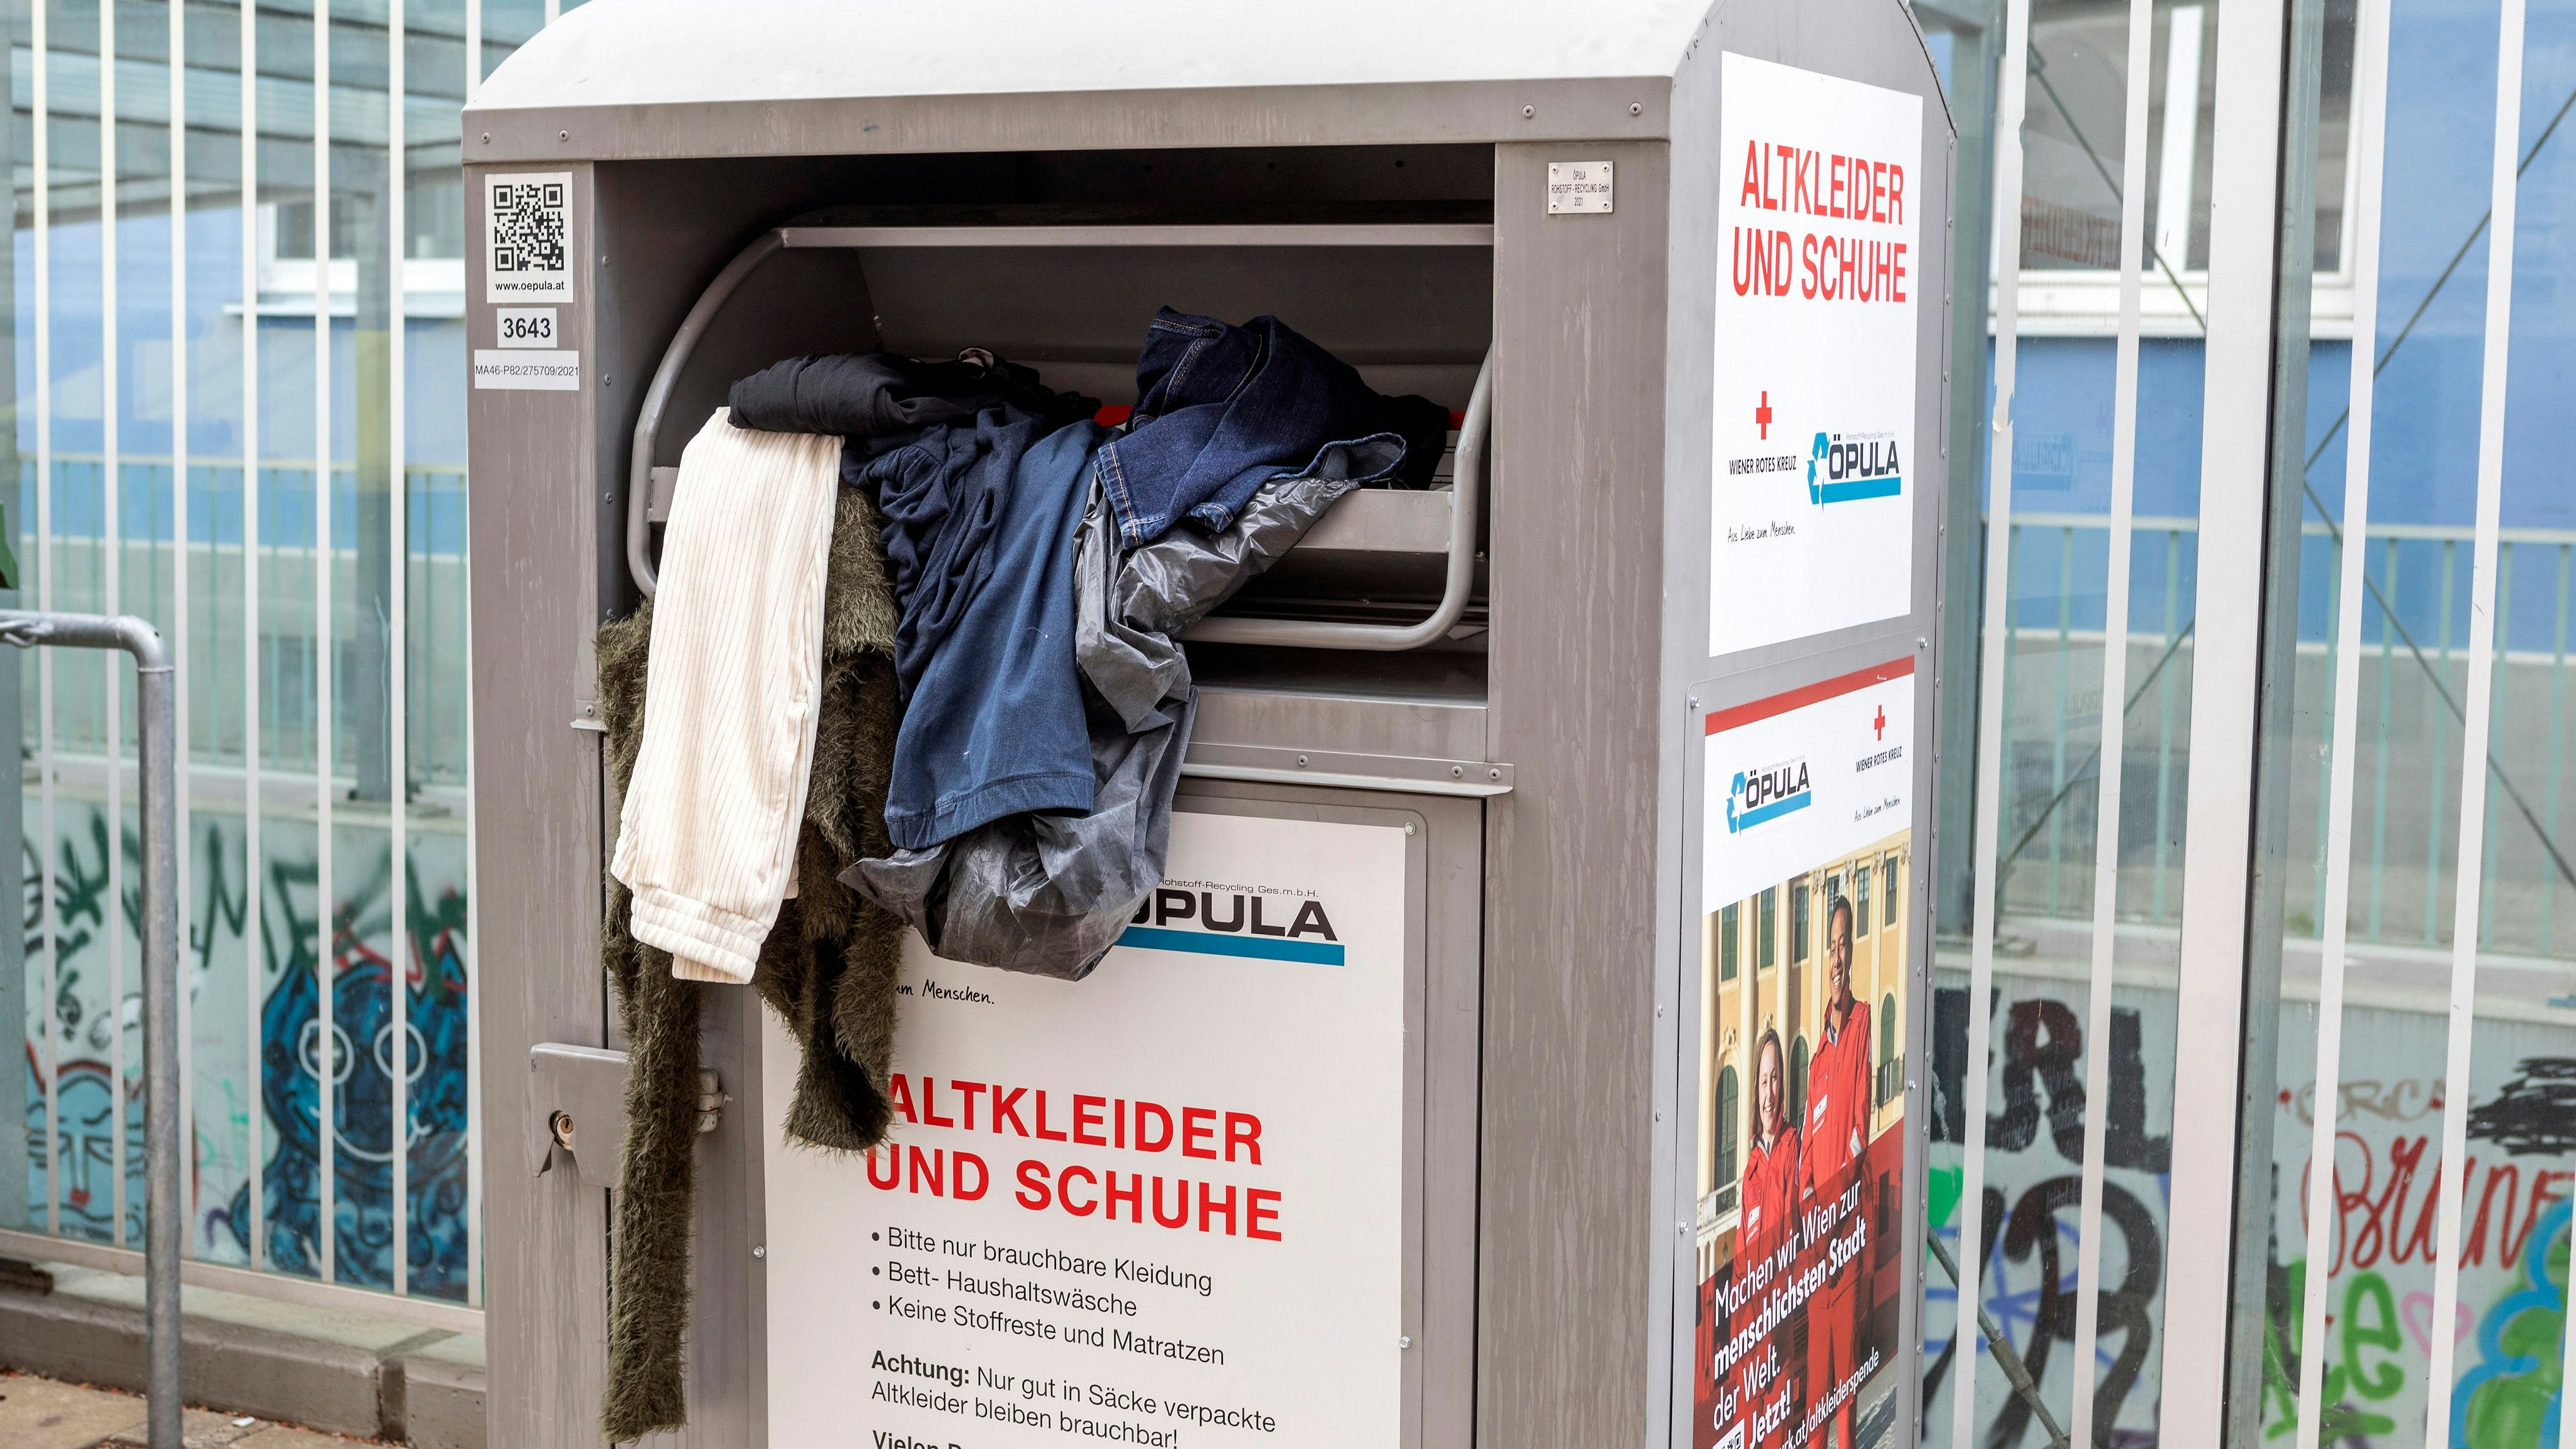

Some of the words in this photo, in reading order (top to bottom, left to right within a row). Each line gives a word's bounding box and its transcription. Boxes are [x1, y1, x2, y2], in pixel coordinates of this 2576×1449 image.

[1741, 140, 1904, 225] ALTKLEIDER
[495, 280, 565, 292] www.oepula.at
[1733, 226, 1793, 297] UND
[1801, 233, 1907, 303] SCHUHE
[503, 317, 551, 339] 3643
[475, 366, 579, 377] MA46-P82/275709/2021
[1729, 459, 1754, 475] WIENER
[1756, 457, 1776, 473] ROTES
[1777, 455, 1796, 471] KREUZ
[1829, 434, 1899, 480] ÖPULA
[1727, 526, 1738, 543] Aus
[1741, 524, 1755, 541] Liebe
[1757, 529, 1768, 538] zum
[1770, 520, 1795, 538] Menschen.
[1746, 761, 1810, 809] ÖPULA
[1856, 757, 1873, 773] WIENER
[1873, 751, 1888, 767] ROTES
[1888, 746, 1902, 761] KREUZ
[1258, 886, 1319, 898] Ges.m.b.H.
[922, 979, 994, 1005] Menschen.
[887, 1073, 1262, 1166] ALTKLEIDER
[867, 1143, 989, 1201] UND
[1014, 1159, 1282, 1242] SCHUHE
[889, 1226, 935, 1252] Bitte
[943, 1239, 976, 1258] nur
[984, 1240, 1106, 1276] brauchbare
[1115, 1258, 1211, 1296] Kleidung
[889, 1260, 939, 1287] Bett-
[947, 1269, 1137, 1316] Haushaltswäsche
[1714, 1258, 1773, 1327] Machen
[1777, 1228, 1799, 1272] wir
[1802, 1202, 1837, 1250] Wien
[1840, 1180, 1861, 1218] zur
[889, 1295, 947, 1323] Keine
[954, 1305, 1056, 1340] Stoffreste
[1064, 1327, 1104, 1347] und
[1113, 1329, 1224, 1365] Matratzen
[1714, 1259, 1826, 1381] menschlichsten
[1829, 1215, 1866, 1275] Stadt
[871, 1350, 969, 1387] Achtung:
[978, 1366, 1015, 1391] Nur
[1021, 1378, 1056, 1399] gut
[1063, 1380, 1080, 1402] in
[1089, 1385, 1157, 1414] Säcke
[1164, 1401, 1276, 1432] verpackte
[871, 1381, 968, 1414] Altkleider
[975, 1397, 1051, 1429] bleiben
[1060, 1411, 1177, 1449] brauchbar!
[1714, 1385, 1740, 1430] der
[1743, 1343, 1781, 1402] Welt.
[1750, 1378, 1791, 1449] Jetzt!
[1779, 1346, 1879, 1449] rk.at/altkleiderspende
